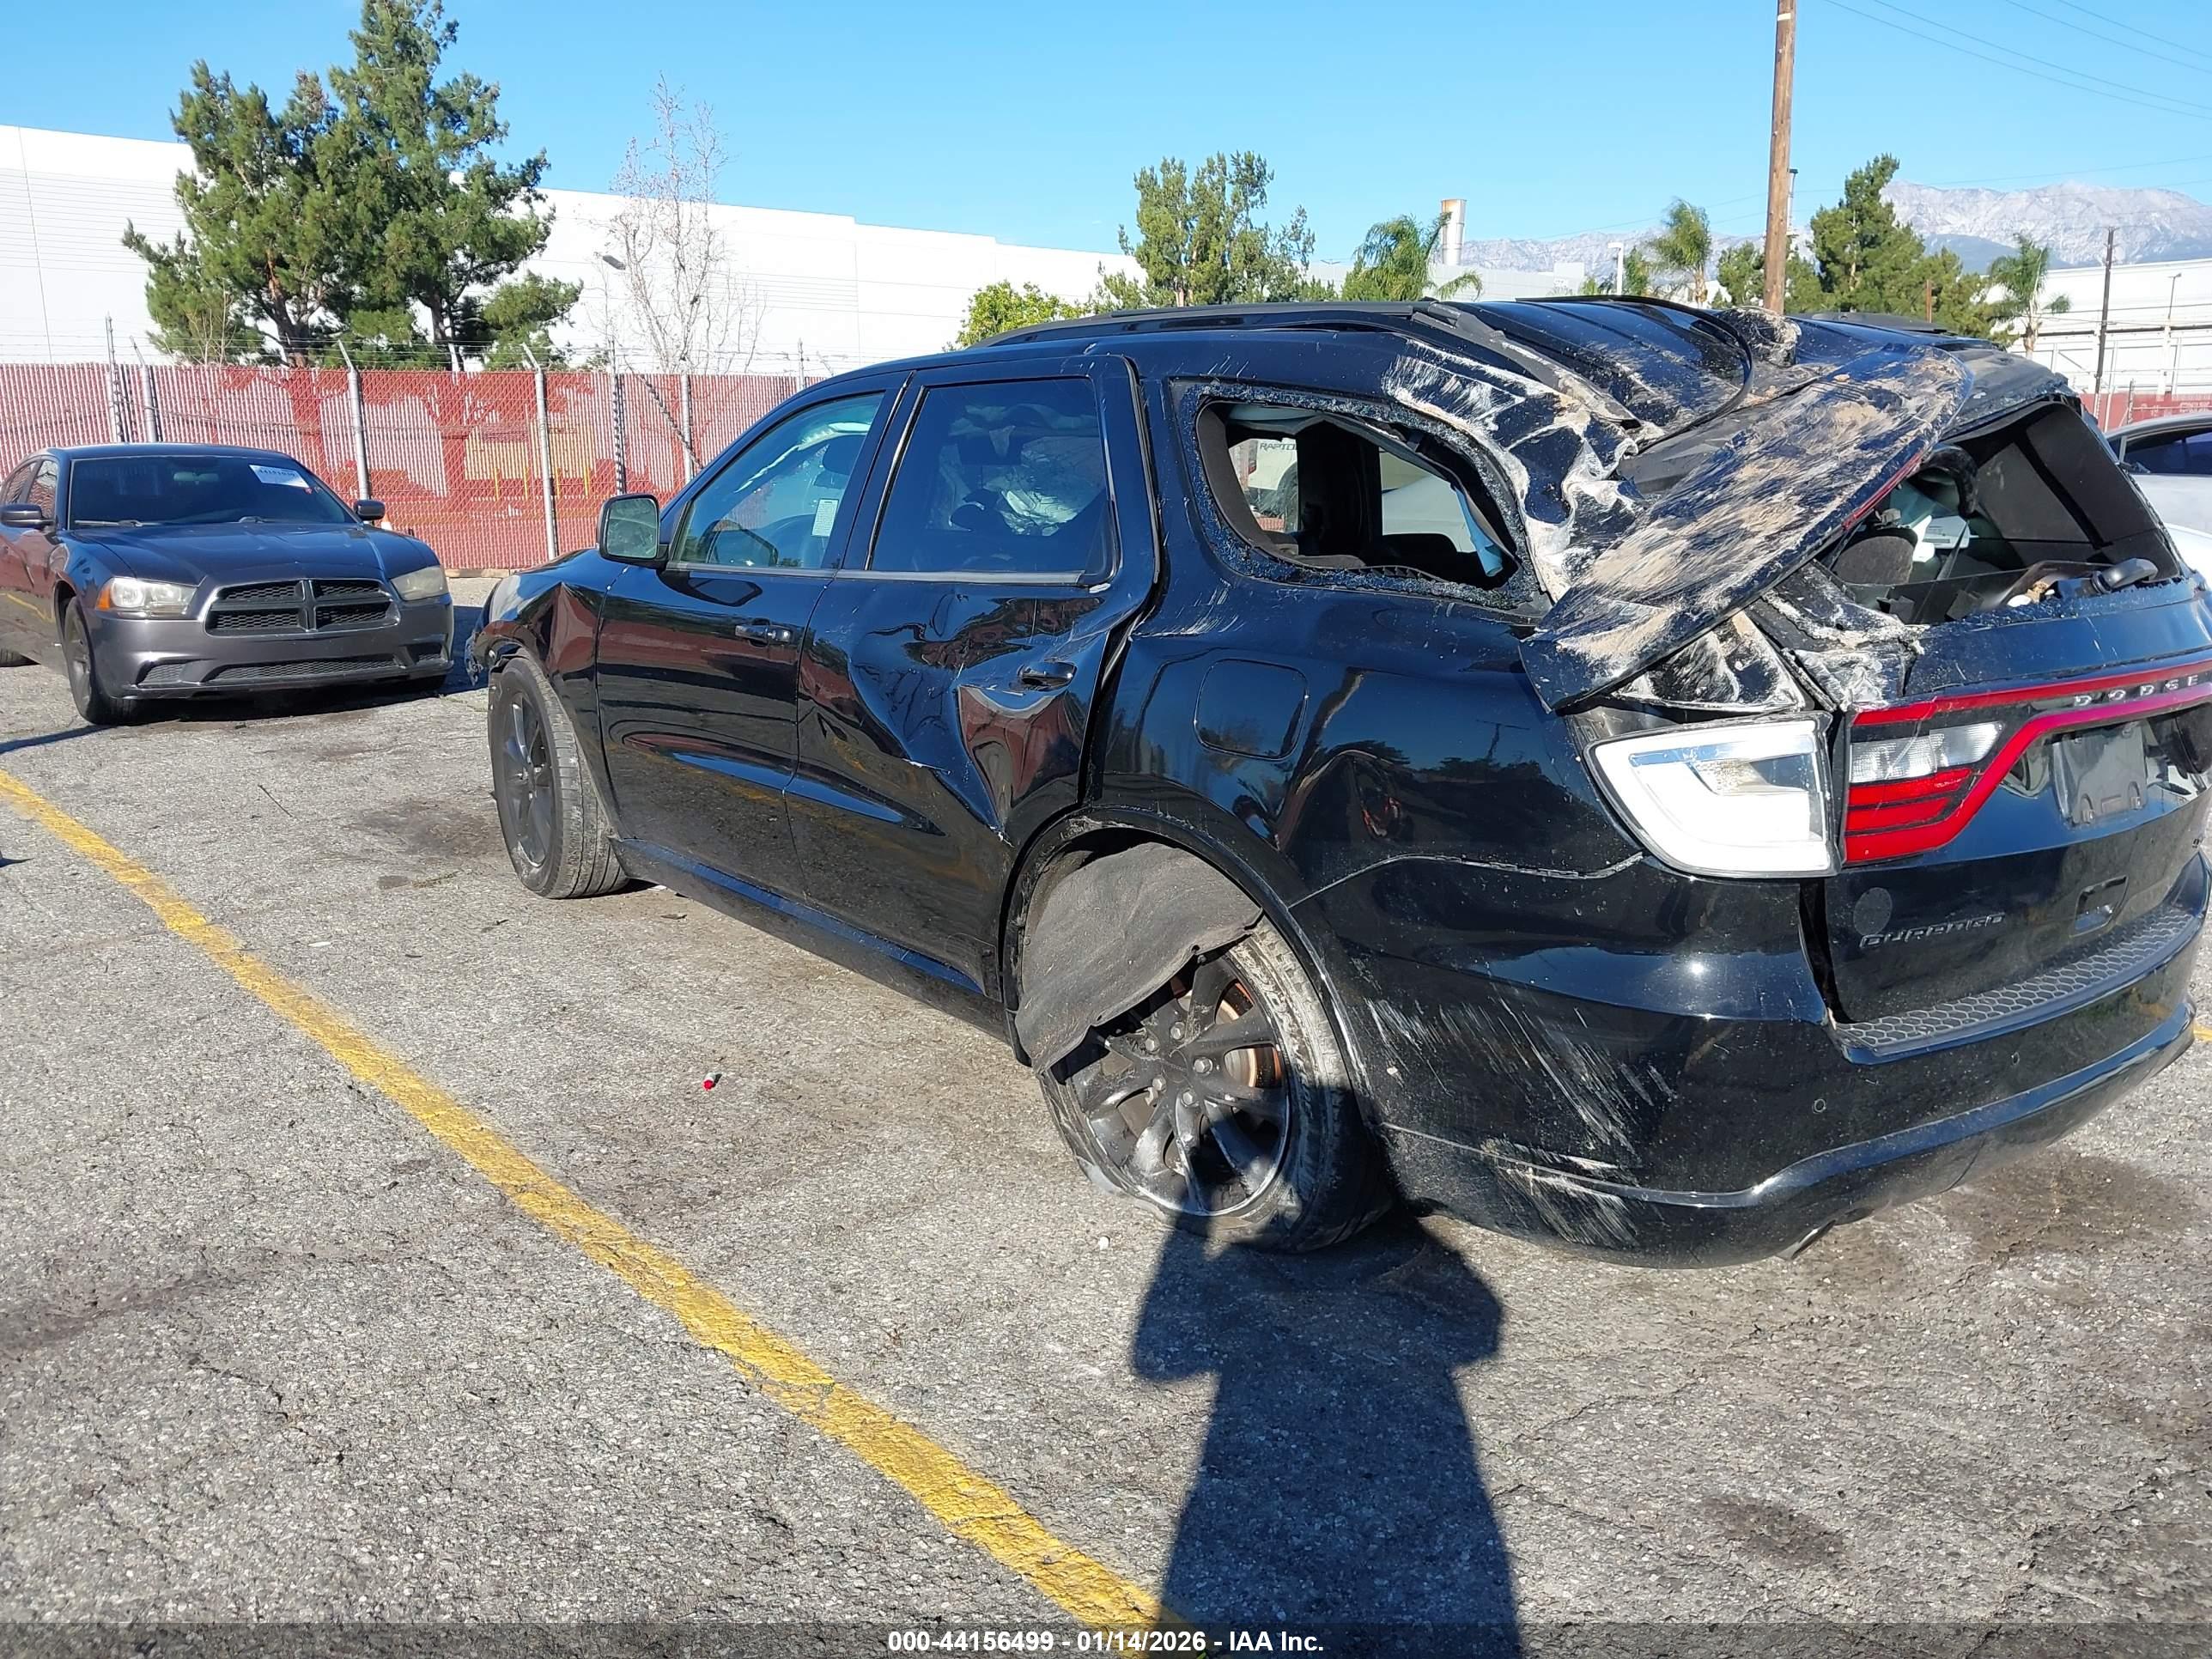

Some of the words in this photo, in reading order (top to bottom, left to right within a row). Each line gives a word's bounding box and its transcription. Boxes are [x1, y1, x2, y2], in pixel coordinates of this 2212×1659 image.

[1260, 442, 1296, 453] RAPTO
[2074, 674, 2199, 707] DODGE
[1859, 911, 2006, 949] DURANGO
